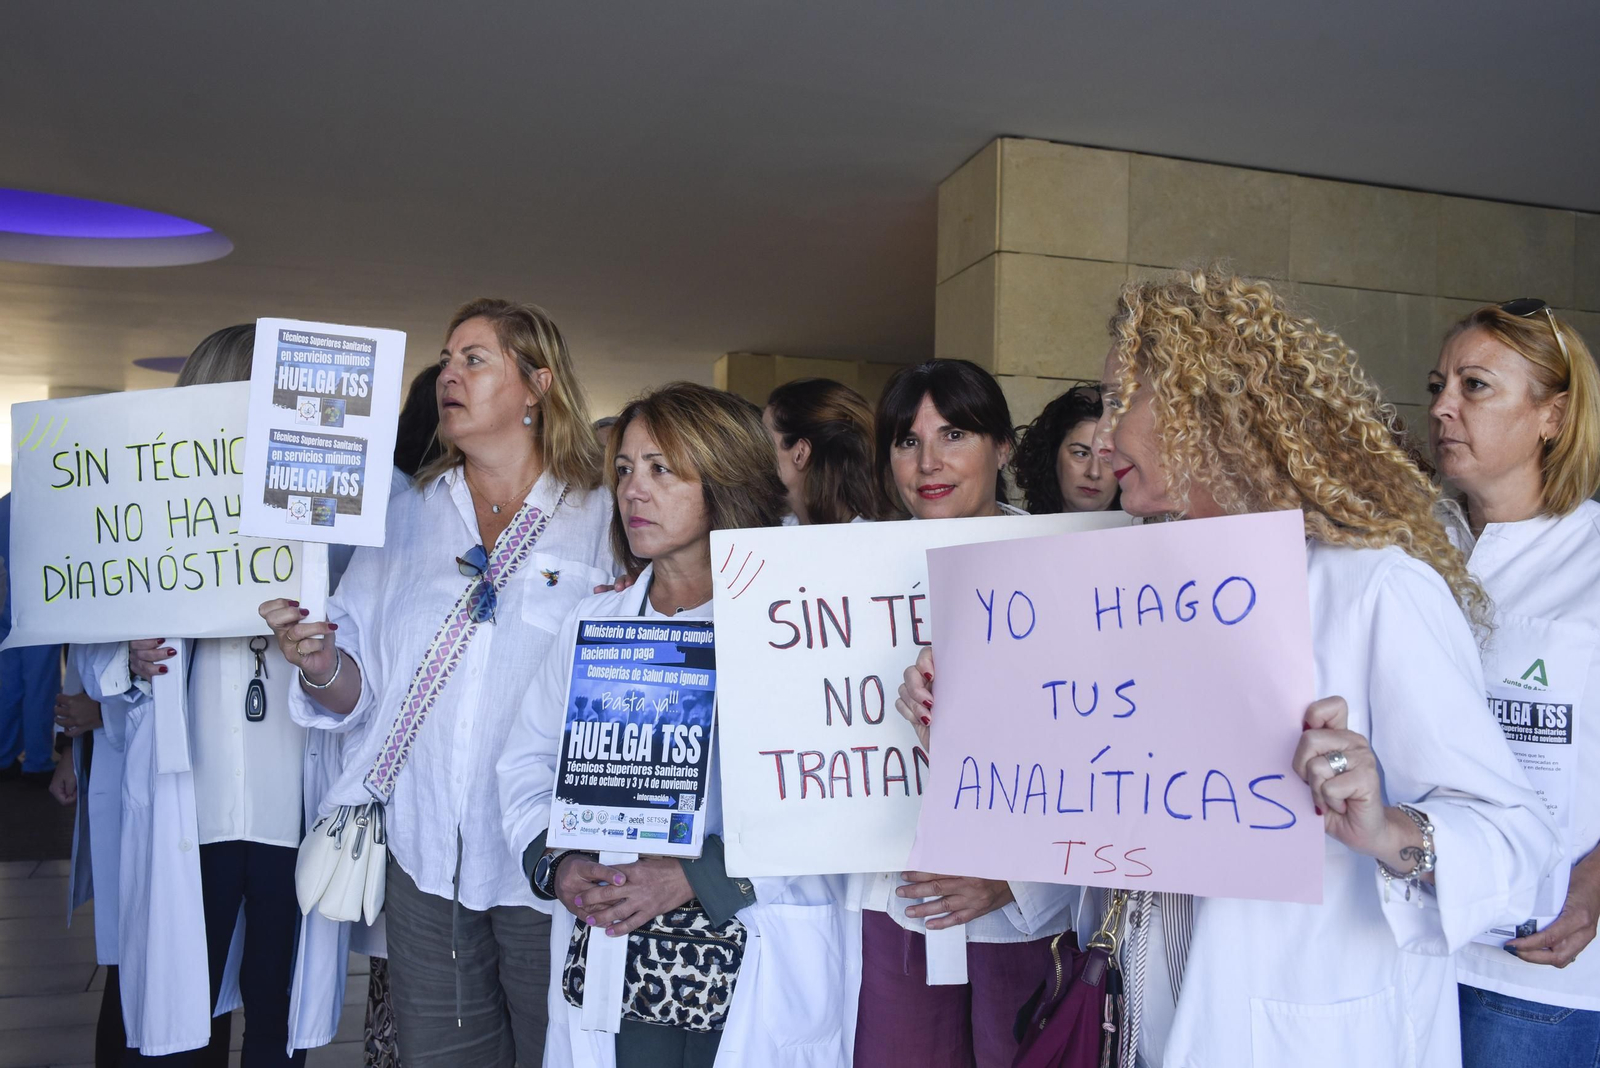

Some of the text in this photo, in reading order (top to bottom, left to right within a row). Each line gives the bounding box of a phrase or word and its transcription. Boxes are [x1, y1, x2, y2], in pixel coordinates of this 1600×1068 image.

[282, 331, 372, 353] Técnicos Superiores Sanitarios
[281, 350, 370, 367] en servicios mínimos
[278, 365, 369, 398] HUELGA TSS
[273, 431, 363, 452] Técnicos Superiores Sanitarios
[51, 442, 109, 490] SIN
[272, 450, 361, 466] en servicios mínimos
[268, 465, 360, 497] HUELGA TSS
[95, 502, 143, 544] NO
[43, 542, 294, 603] DIAGNÓSTICO
[768, 582, 931, 649] SIN TÉ
[976, 576, 1256, 644] YO HAGO
[584, 624, 714, 645] Ministerio de Sanidad no cumple
[581, 647, 655, 661] Hacienda no paga
[587, 664, 709, 686] Consejerías de Salud nos ignoran
[1503, 678, 1521, 688] Junta
[601, 691, 645, 713] Basta
[824, 675, 885, 726] NO
[1042, 679, 1137, 719] TUS
[1536, 704, 1567, 729] TSS
[568, 721, 703, 764] HUELGA TSS
[1534, 727, 1567, 736] Sanitarios
[567, 761, 699, 777] Técnicos Superiores Sanitarios
[565, 773, 698, 791] 30 y 31 de octubre y 3 y 4 de noviembre
[954, 745, 1297, 830] ANALÍTICAS
[1052, 840, 1153, 877] TSS
